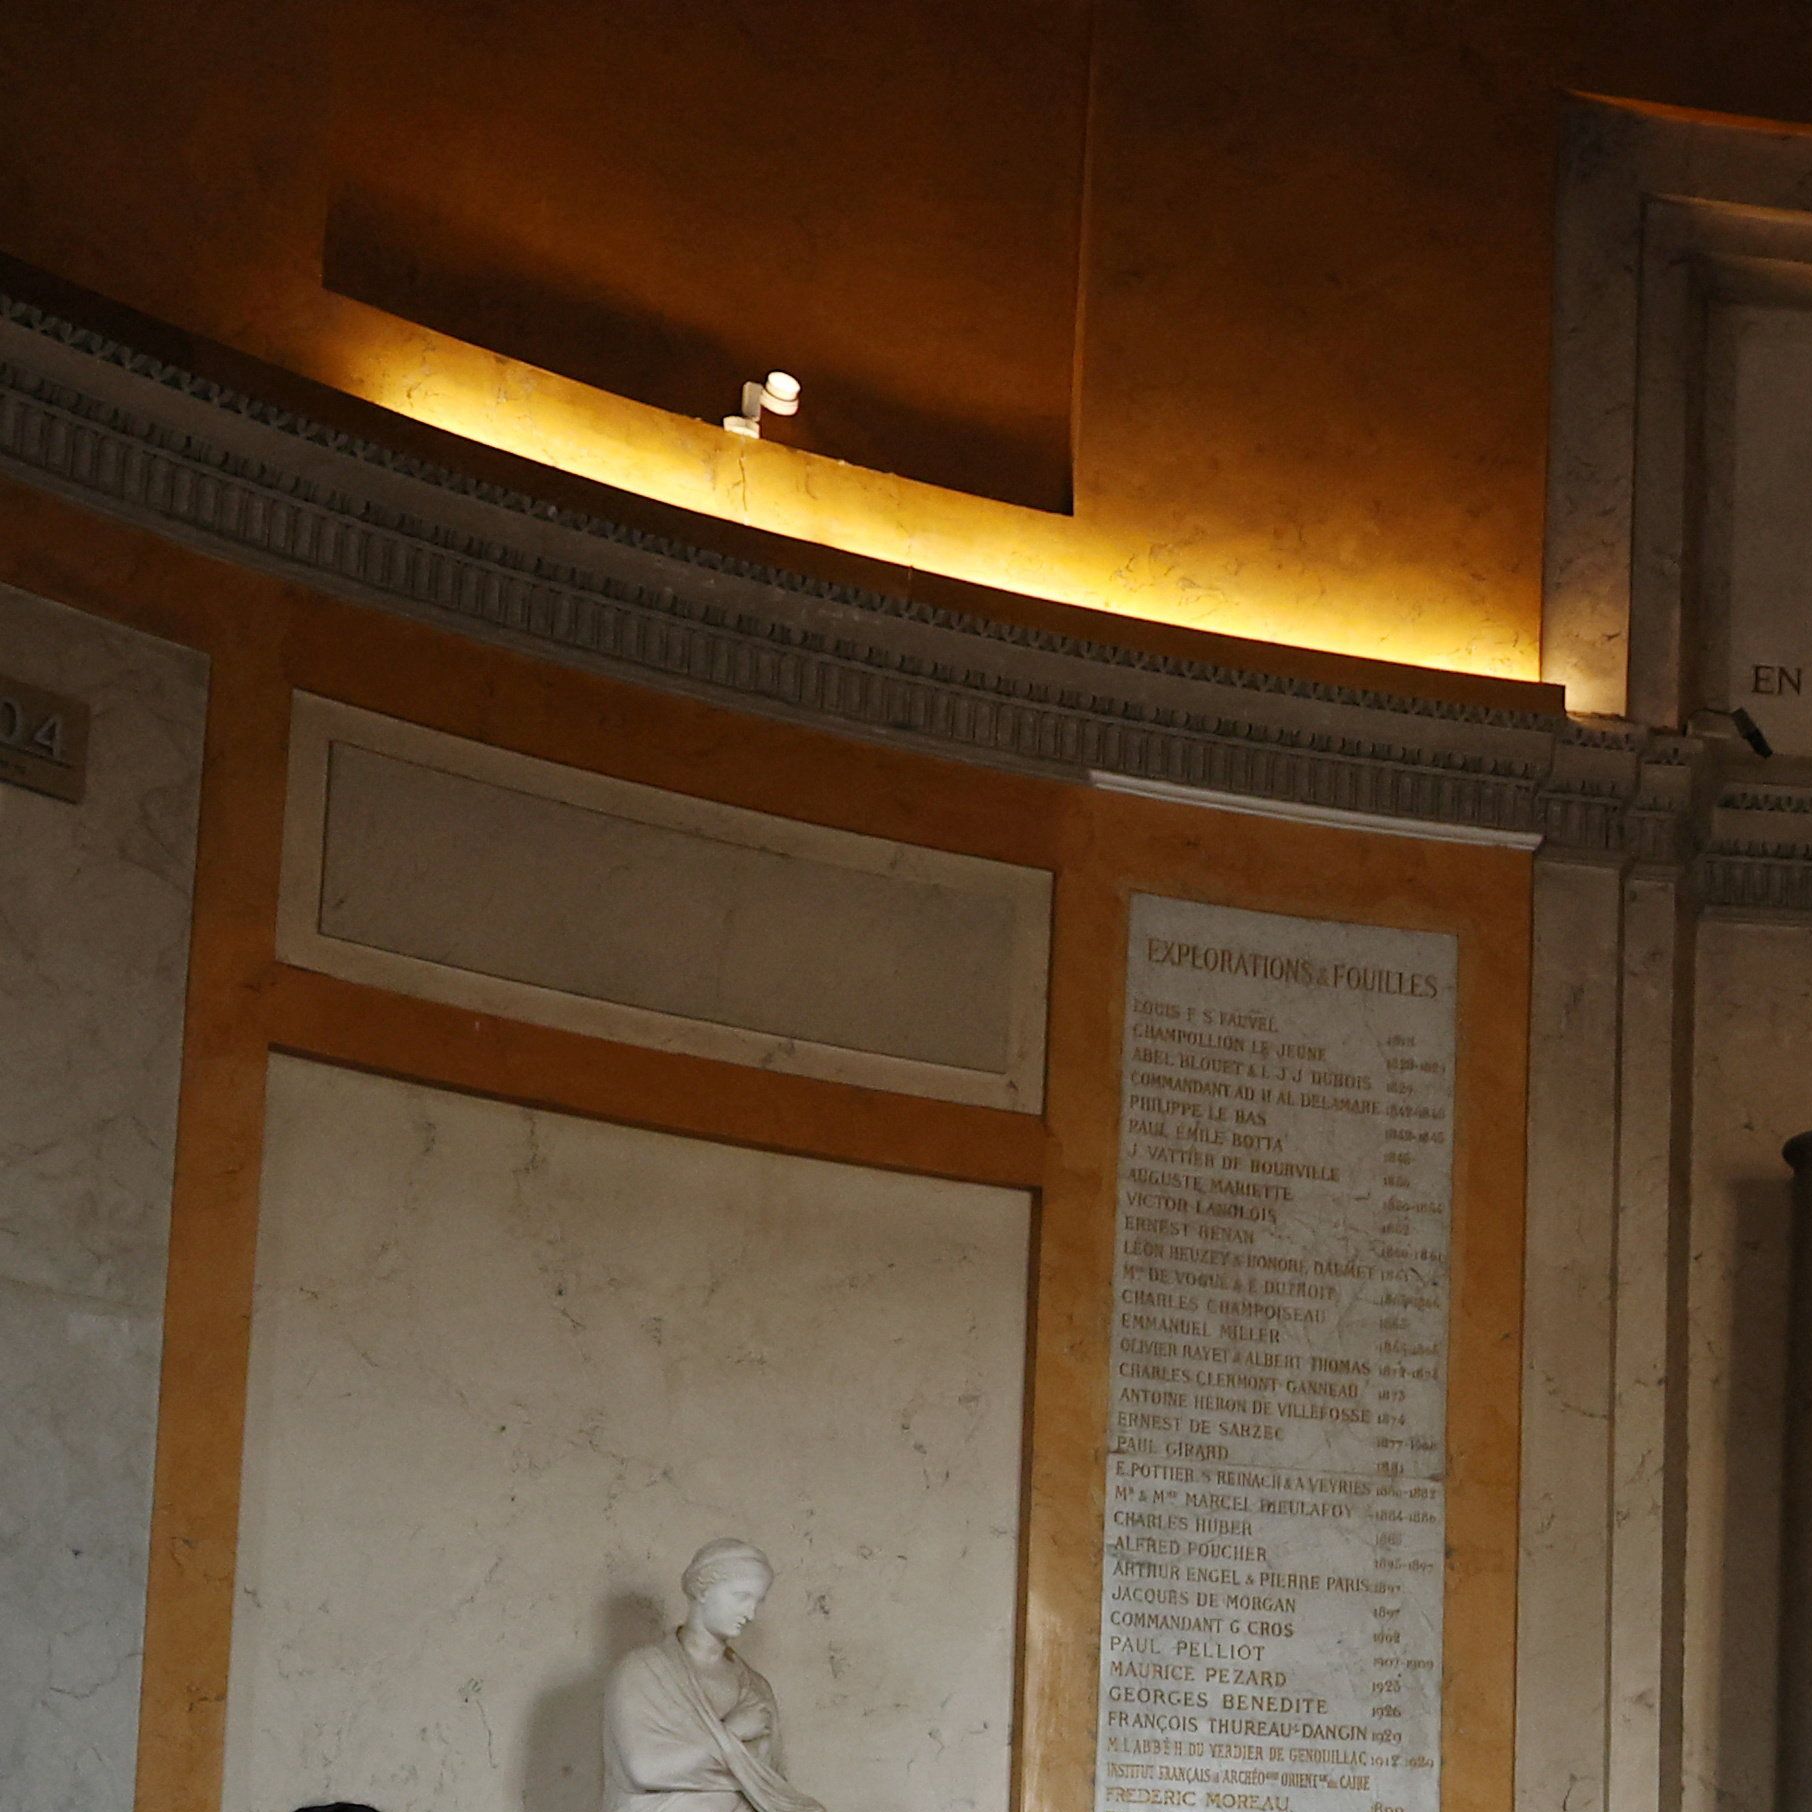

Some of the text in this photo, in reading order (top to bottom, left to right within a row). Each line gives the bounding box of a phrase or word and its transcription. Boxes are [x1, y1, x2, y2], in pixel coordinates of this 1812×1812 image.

[1751, 664, 1803, 695] EN
[1147, 938, 1312, 984] EXPLORATIONS
[1333, 963, 1437, 1000] FOUILLES
[1189, 1417, 1211, 1434] DE
[1184, 1491, 1249, 1513] MARCEL
[1113, 1510, 1187, 1531] CHARLES
[1112, 1559, 1180, 1582] ARTHUR
[1186, 1565, 1240, 1586] ENGEL
[1259, 1571, 1320, 1591] PIERRE
[1326, 1575, 1369, 1594] PARIS
[1111, 1584, 1296, 1614] JACQUES DE MORGAN
[1109, 1609, 1295, 1639] COMMANDANT CROS
[1109, 1635, 1266, 1662] PAUL PELLIOT
[1109, 1659, 1195, 1682] MAURICE
[1108, 1684, 1208, 1708] GEORGES
[1107, 1710, 1198, 1736] FRANÇOIS
[1105, 1785, 1197, 1807] FREDERIC
